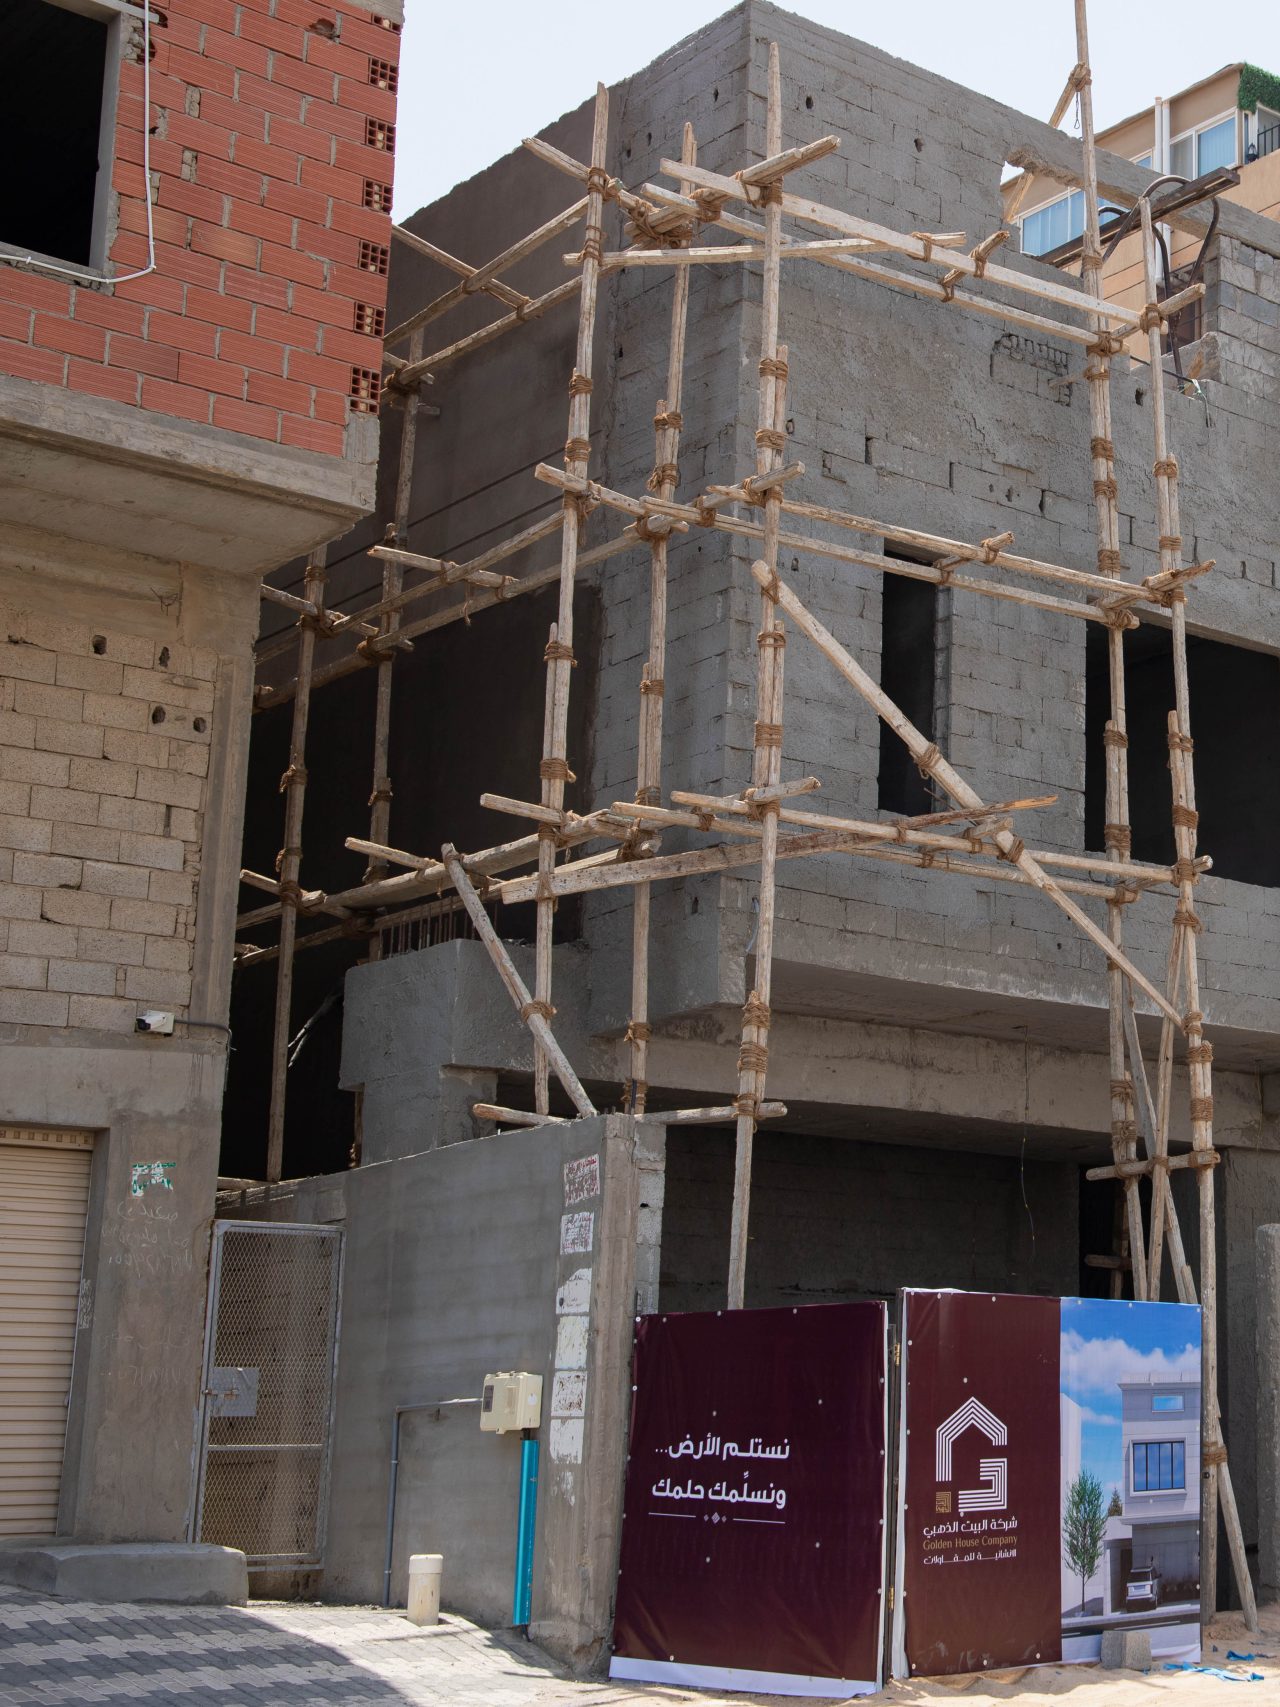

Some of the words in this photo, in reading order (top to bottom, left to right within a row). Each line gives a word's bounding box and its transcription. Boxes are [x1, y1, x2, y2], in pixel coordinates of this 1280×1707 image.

[651, 1478, 705, 1500] حلمك
[923, 1520, 959, 1538] الذهبي
[960, 1519, 988, 1534] البيت
[990, 1515, 1018, 1532] شركة
[923, 1539, 952, 1551] Golden
[955, 1536, 980, 1548] House
[981, 1535, 1018, 1548] Company
